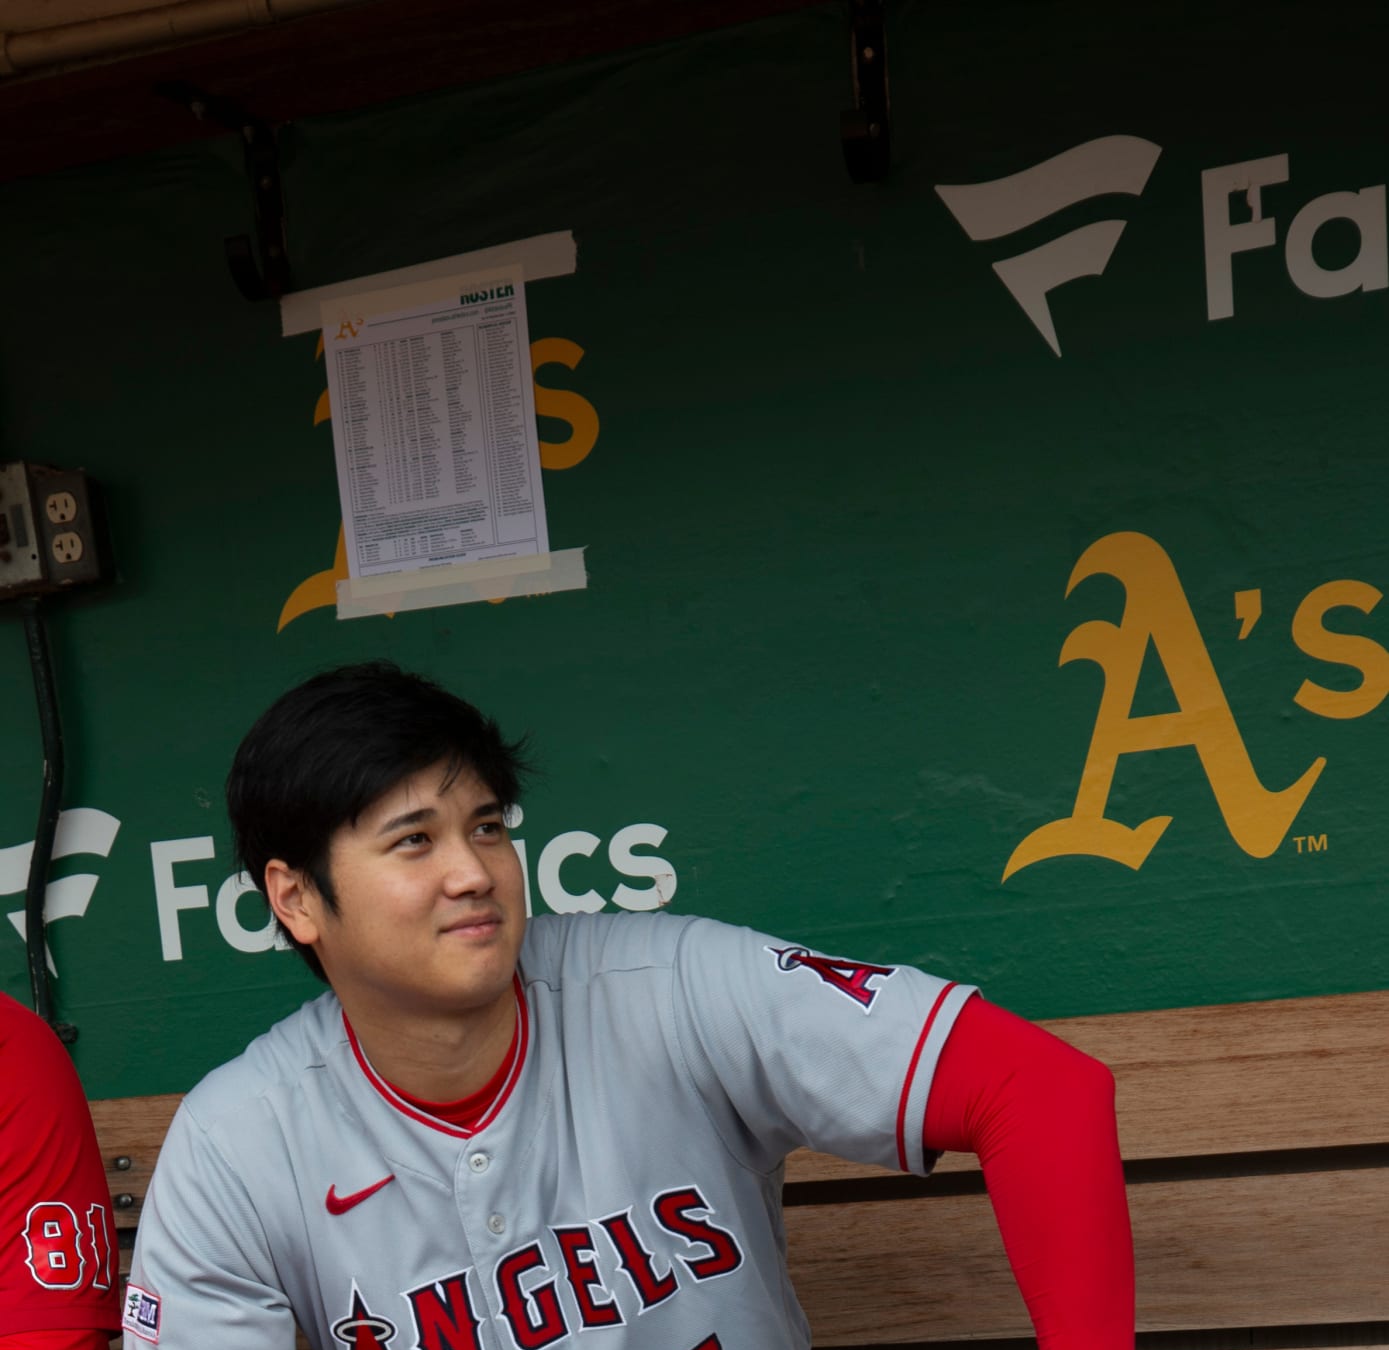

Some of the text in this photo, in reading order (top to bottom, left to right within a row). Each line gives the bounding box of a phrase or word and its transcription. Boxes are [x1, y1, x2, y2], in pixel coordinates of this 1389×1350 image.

[1001, 530, 1389, 885] A's
[150, 803, 678, 961] Faics
[1292, 833, 1329, 855] TM
[21, 1201, 111, 1291] 81
